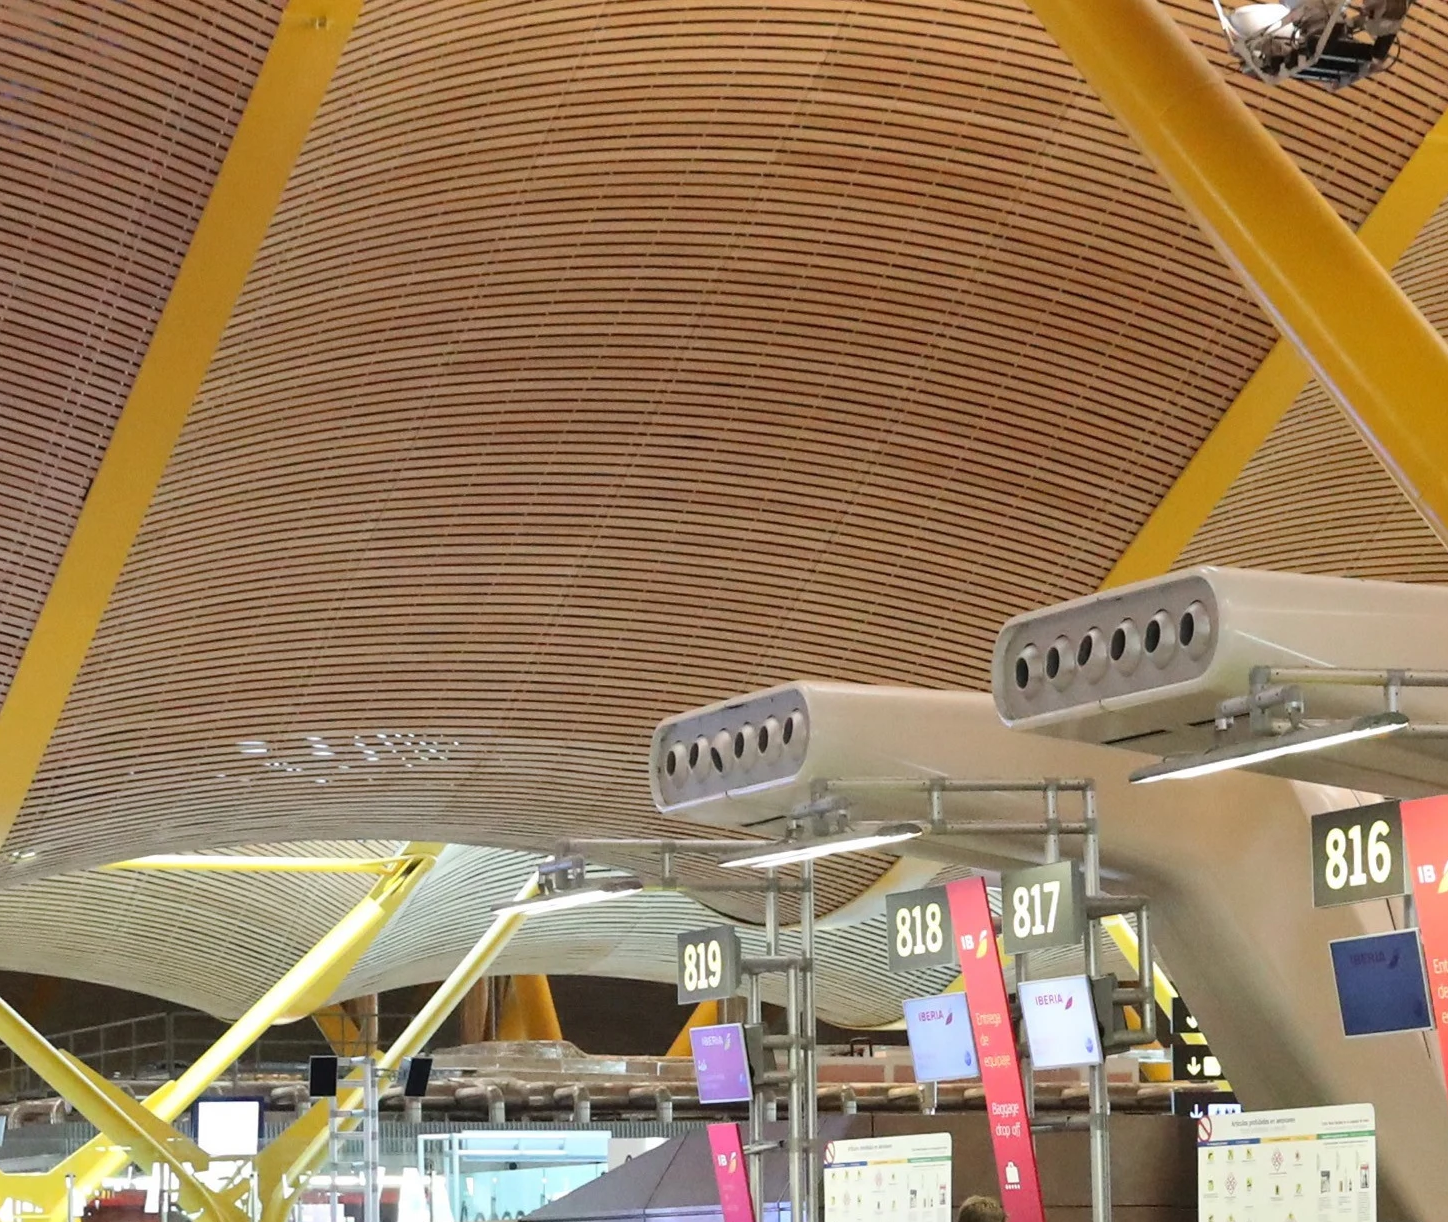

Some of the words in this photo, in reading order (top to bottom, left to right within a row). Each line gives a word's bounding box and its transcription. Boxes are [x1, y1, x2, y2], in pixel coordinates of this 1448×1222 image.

[1325, 820, 1391, 890] 816
[1417, 864, 1436, 884] IB
[1012, 880, 1060, 939] 817
[896, 902, 943, 957] 818
[960, 934, 974, 950] IB
[683, 940, 722, 992] 819
[1035, 994, 1063, 1005] IBERIA
[918, 1010, 944, 1022] IBERIA
[991, 1102, 1019, 1118] Baggage
